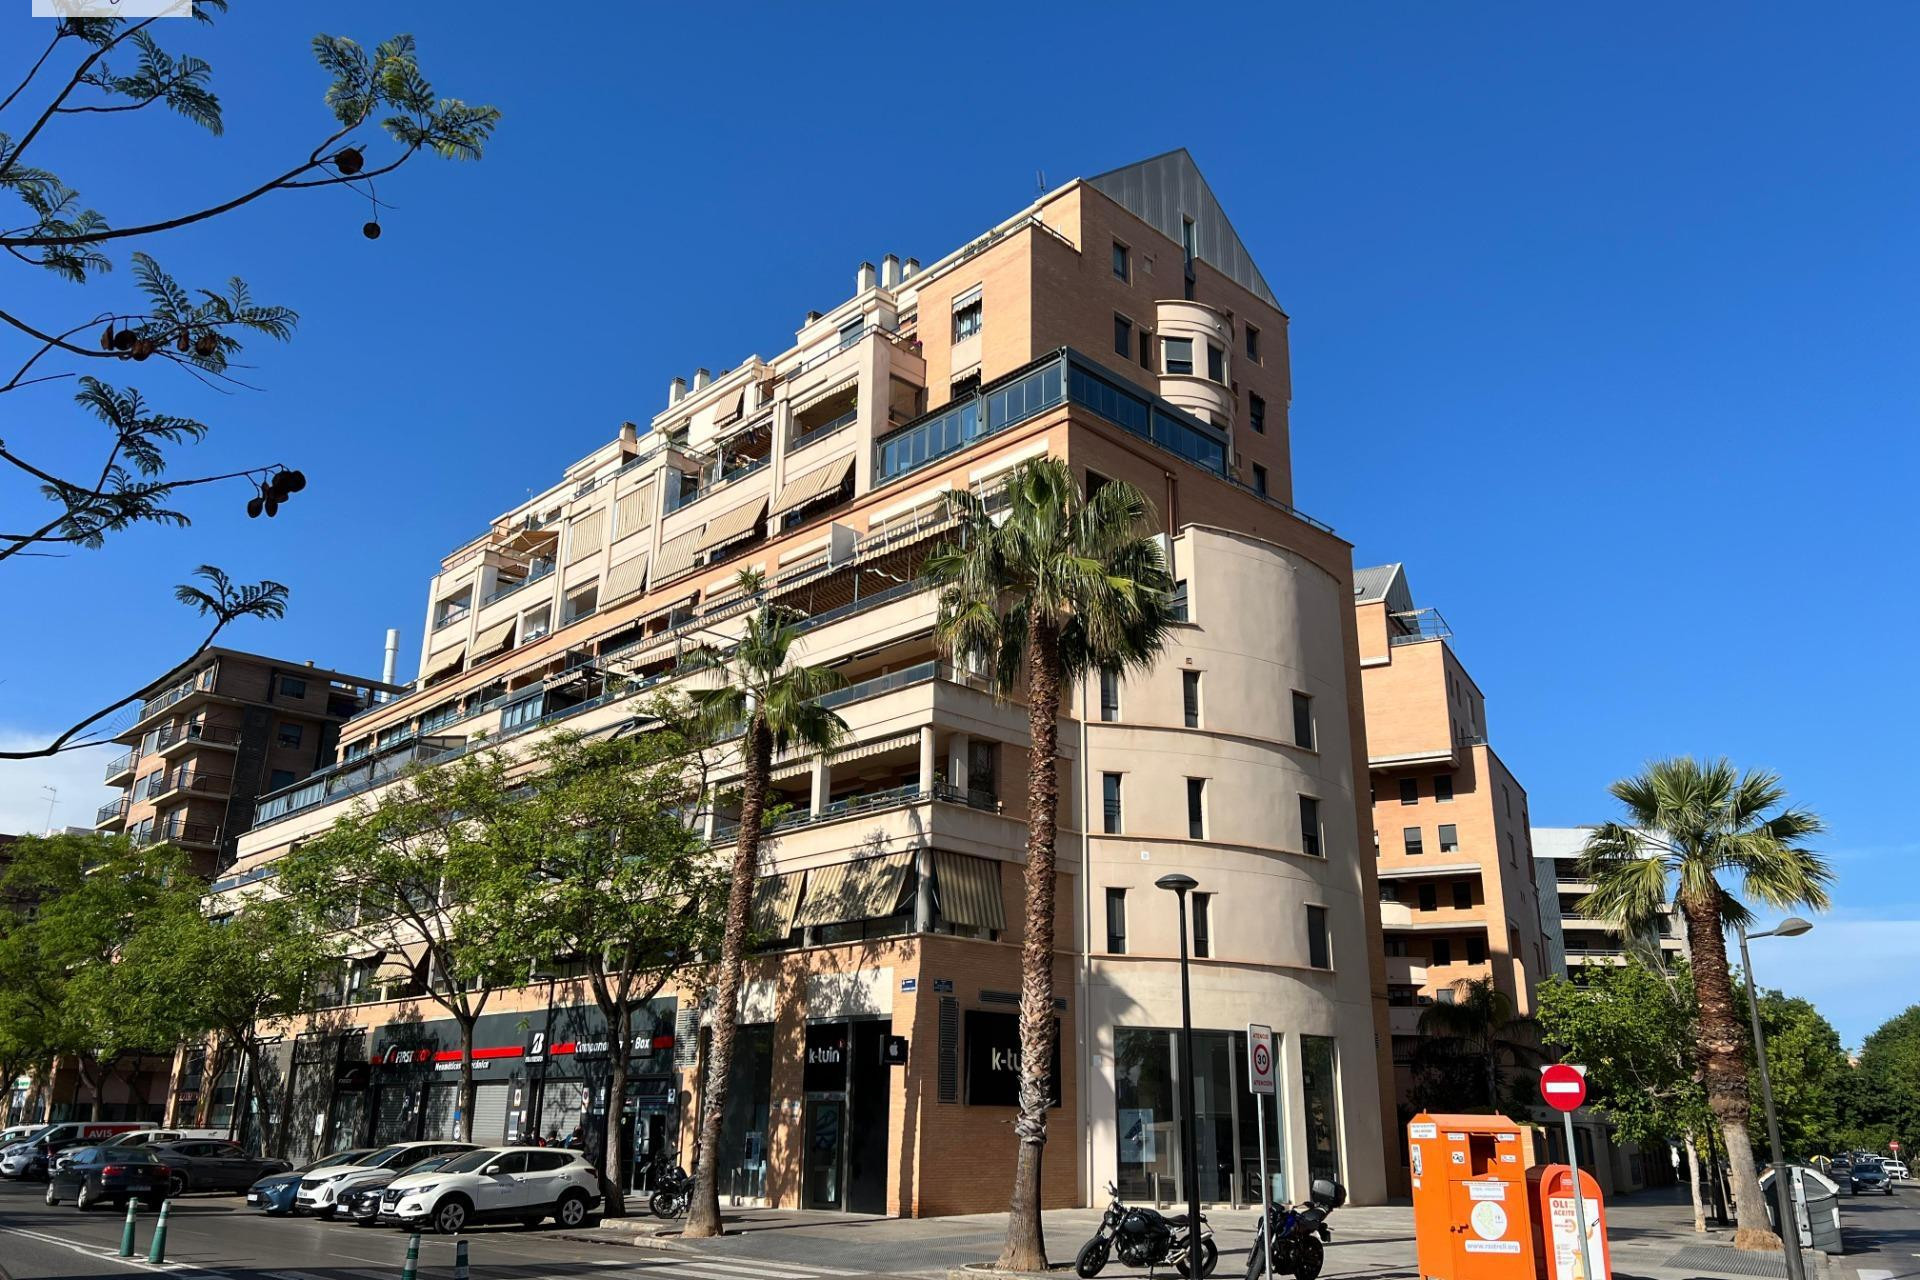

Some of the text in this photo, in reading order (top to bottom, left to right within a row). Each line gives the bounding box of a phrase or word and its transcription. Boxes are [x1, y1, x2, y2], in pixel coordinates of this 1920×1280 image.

[634, 1036, 651, 1050] Box
[809, 1046, 840, 1064] k-tuin
[991, 1047, 1022, 1071] k-tu
[1257, 1054, 1267, 1065] 30
[89, 1128, 113, 1139] AVIS
[1552, 1199, 1569, 1209] OLI
[1553, 1209, 1575, 1217] ACEITE
